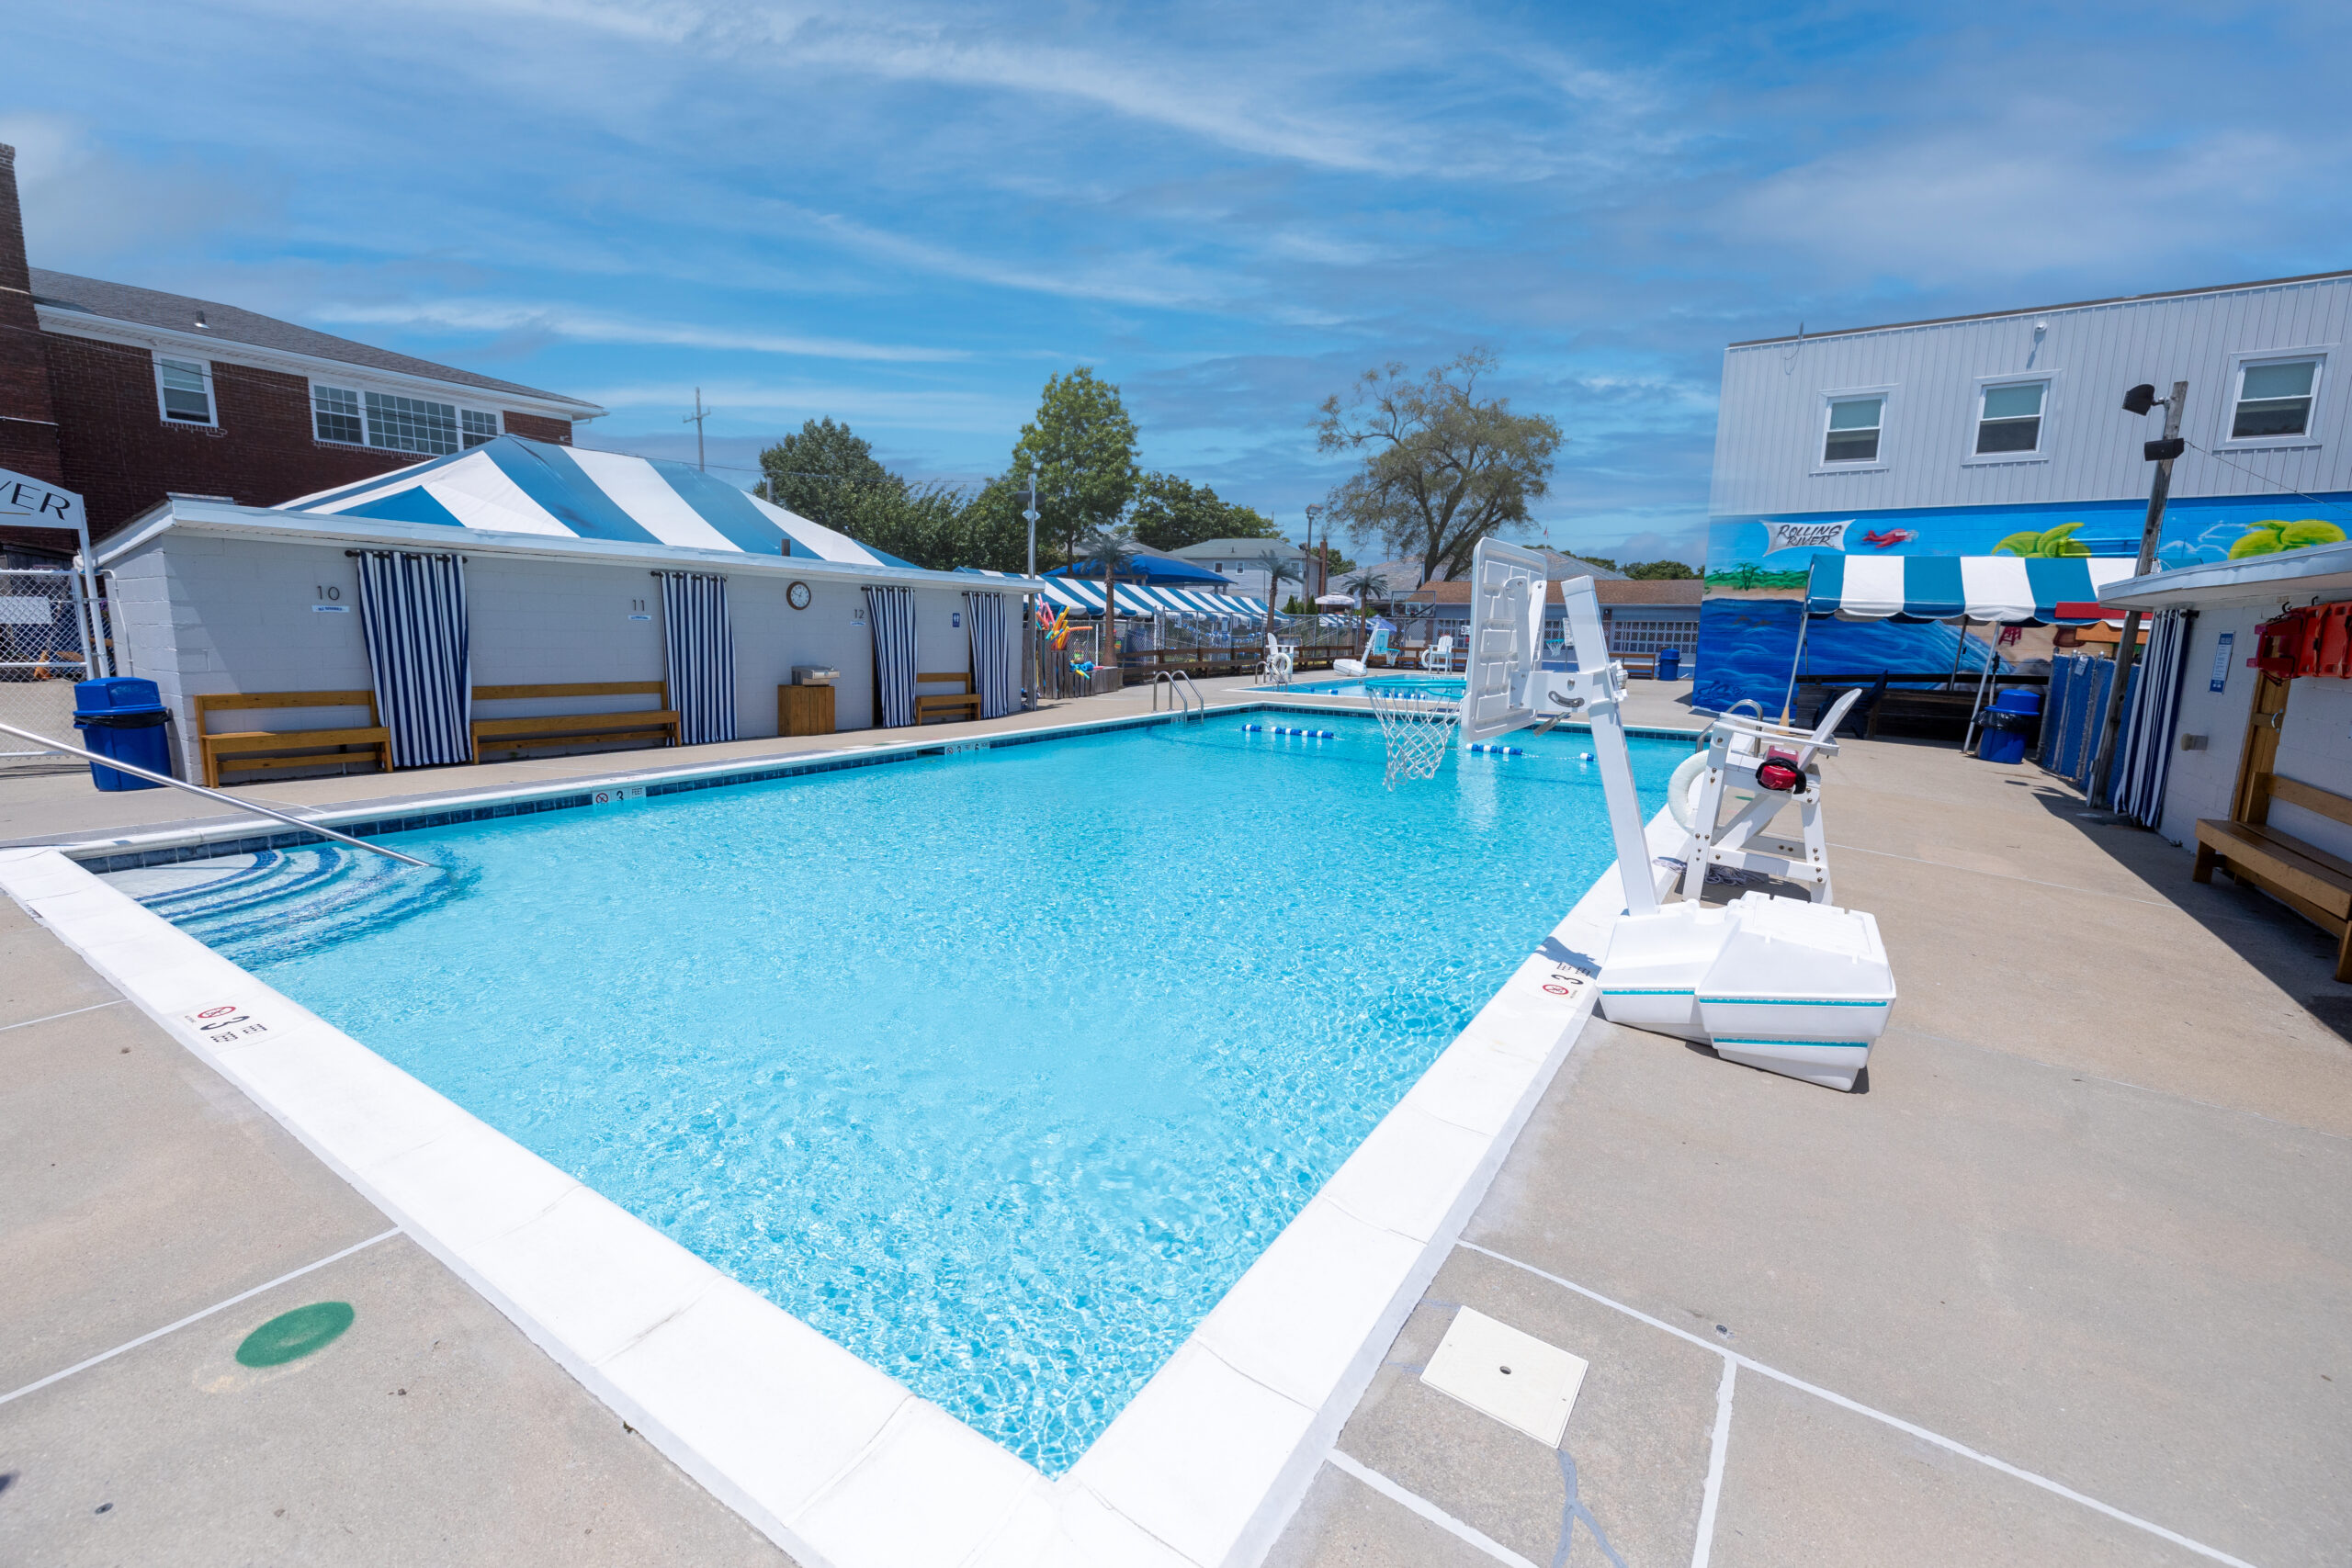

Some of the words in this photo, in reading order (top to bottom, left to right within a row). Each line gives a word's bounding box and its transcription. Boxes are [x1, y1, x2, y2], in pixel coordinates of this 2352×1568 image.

[1776, 525, 1842, 539] ROLLING
[1786, 535, 1837, 548] RIVER
[316, 585, 340, 601] 10
[632, 599, 645, 612] 11
[854, 608, 865, 619] 12
[616, 790, 624, 802] 3
[1551, 974, 1584, 985] 3
[199, 1015, 250, 1031] 3
